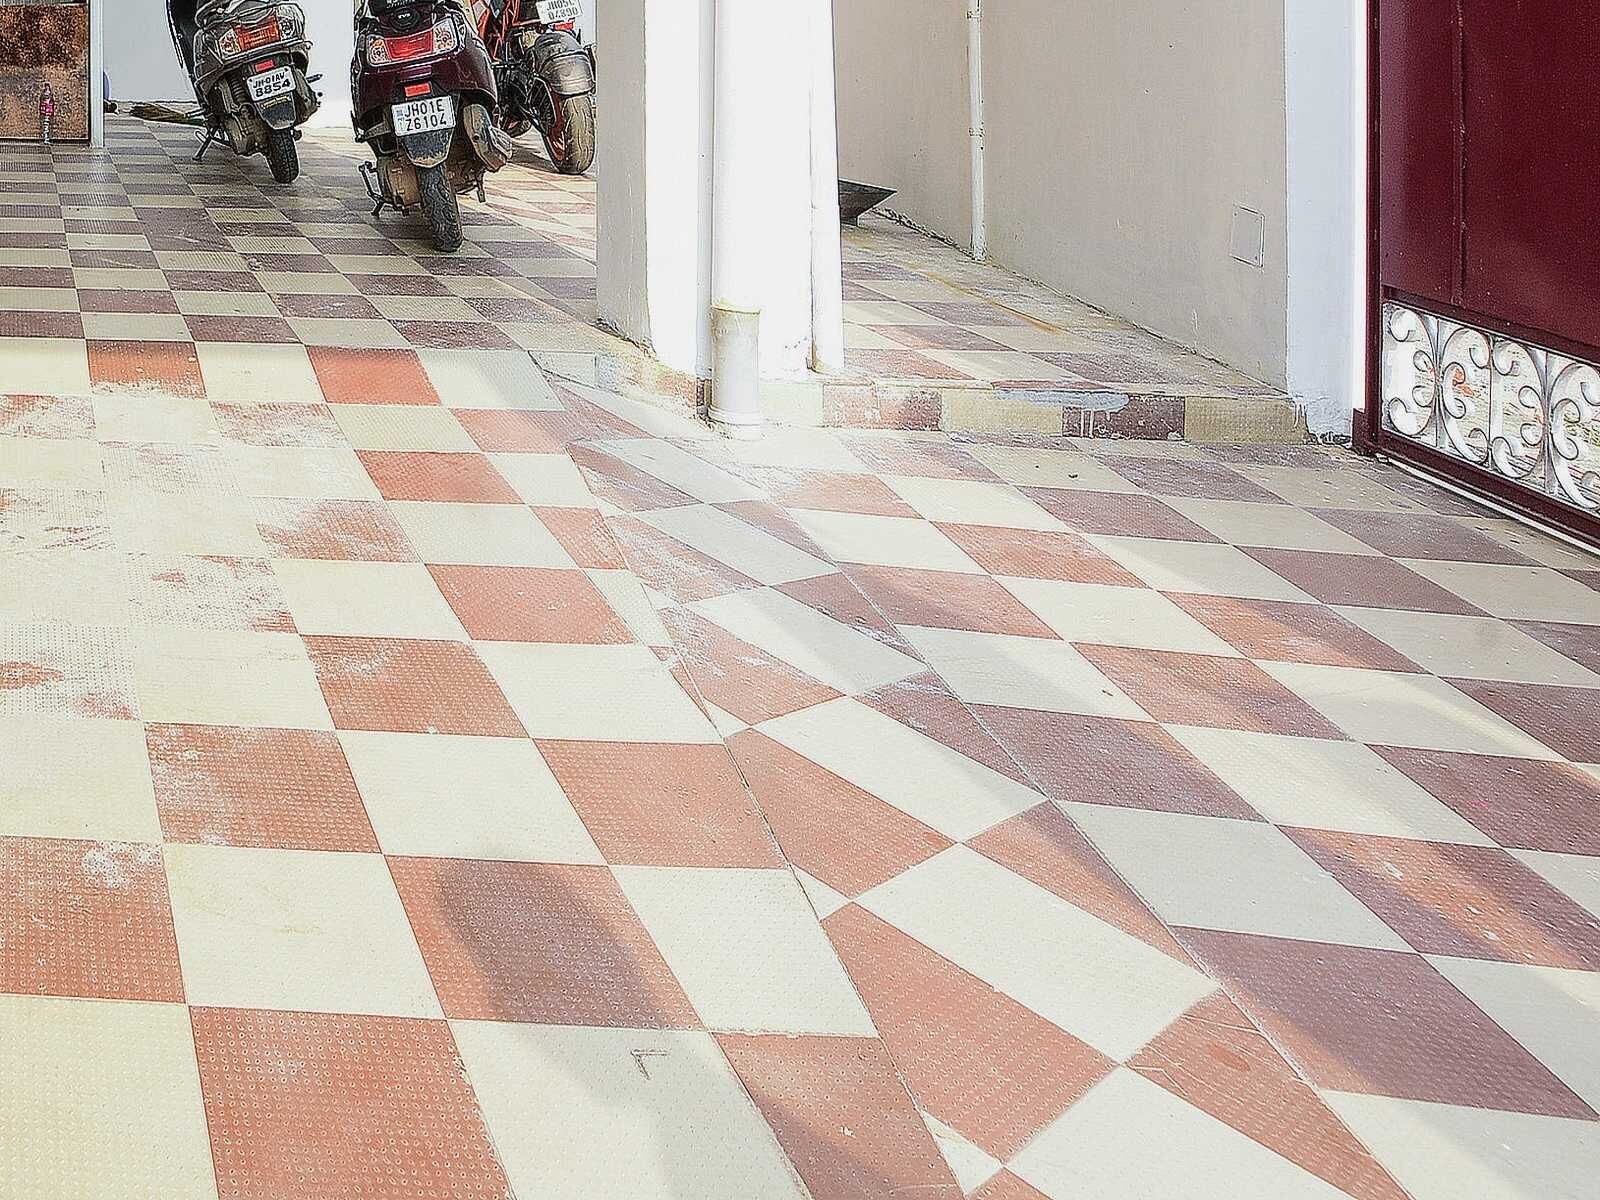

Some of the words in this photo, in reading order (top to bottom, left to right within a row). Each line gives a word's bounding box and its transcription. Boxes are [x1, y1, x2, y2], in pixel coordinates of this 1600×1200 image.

[256, 79, 291, 97] 8854
[405, 99, 445, 118] JH01E
[405, 113, 447, 131] Z6104
